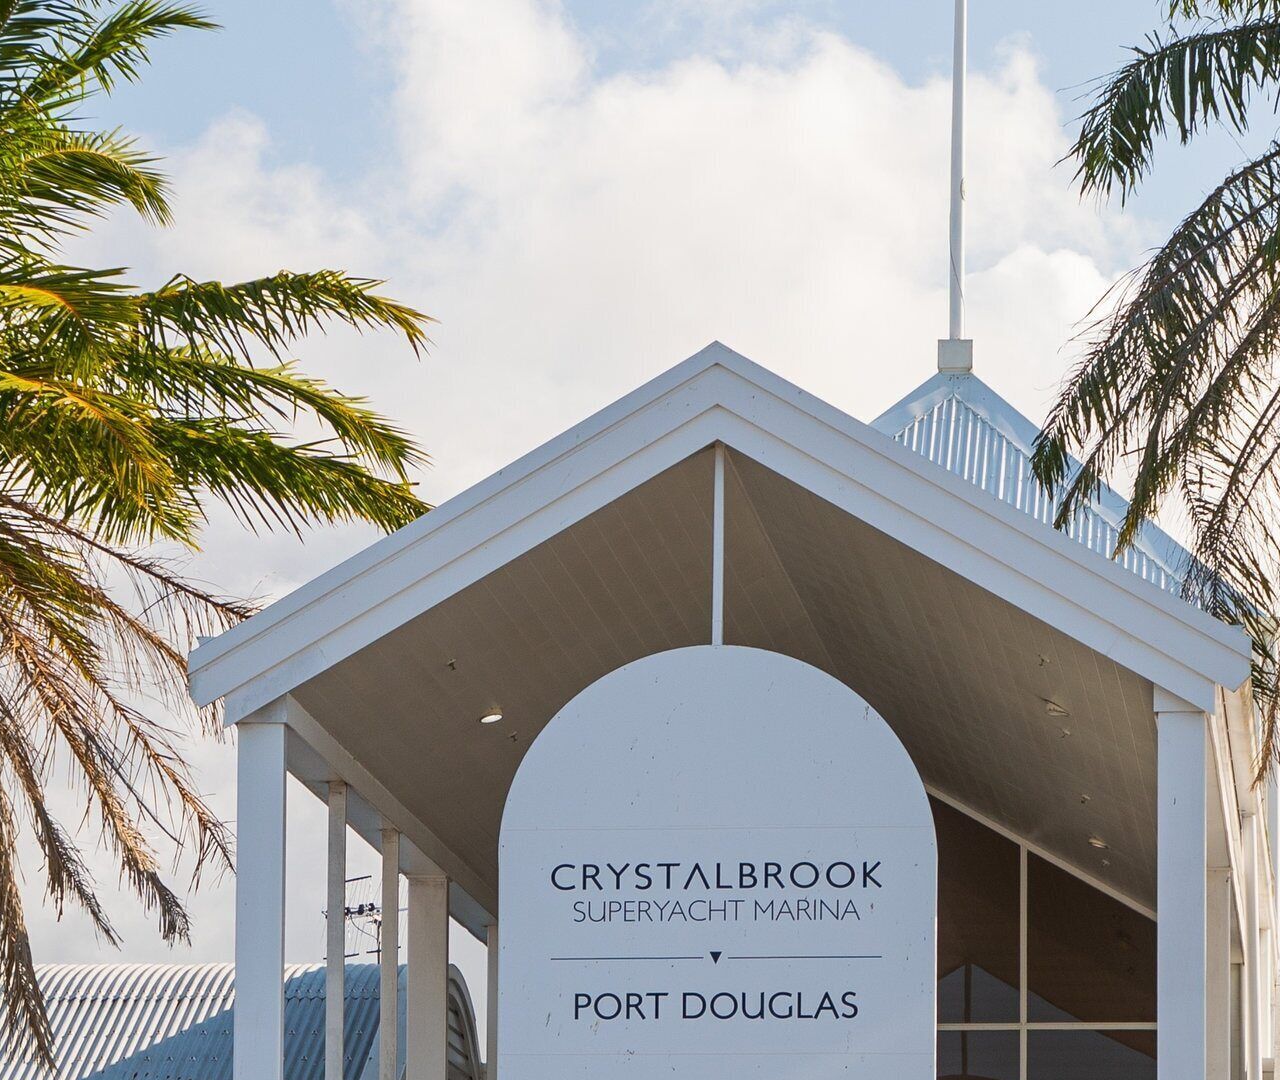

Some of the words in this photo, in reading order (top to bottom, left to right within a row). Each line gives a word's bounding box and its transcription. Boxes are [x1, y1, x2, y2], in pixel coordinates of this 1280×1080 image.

[550, 861, 882, 891] CRYSTALBROOK
[573, 900, 745, 923] SUPERYACHT
[754, 899, 861, 921] MARINA
[574, 992, 669, 1020] PORT
[682, 991, 859, 1020] DOUGLAS
